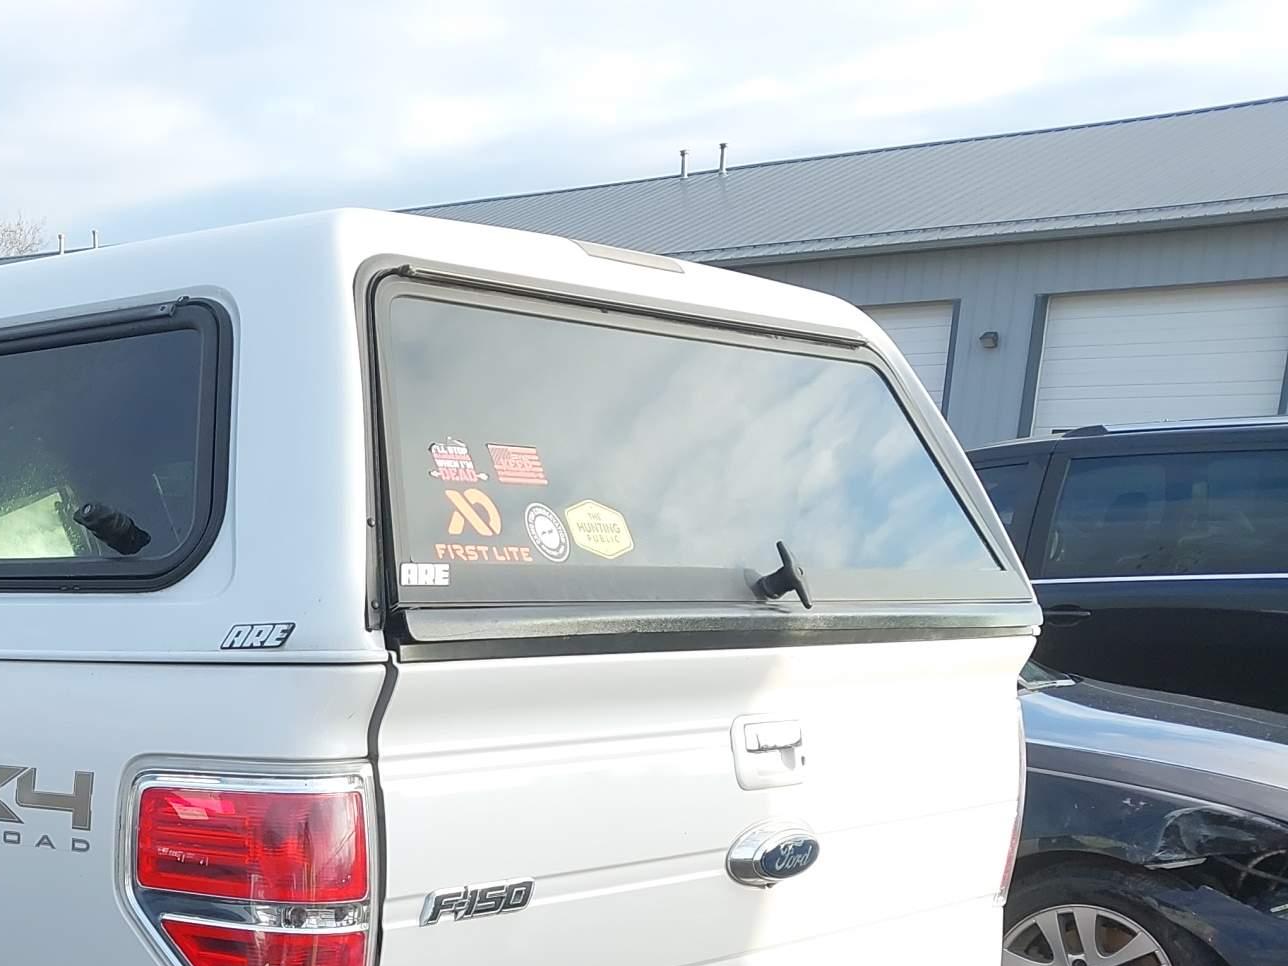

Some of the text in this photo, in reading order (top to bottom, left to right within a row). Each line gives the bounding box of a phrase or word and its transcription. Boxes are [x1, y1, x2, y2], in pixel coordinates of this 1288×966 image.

[439, 468, 479, 482] DEAD
[576, 521, 621, 535] HUNTING
[586, 534, 621, 544] PUBLIC
[435, 543, 533, 562] FIRST LITE
[400, 563, 450, 586] ARE
[220, 622, 296, 650] ARE
[775, 840, 813, 871] Ford
